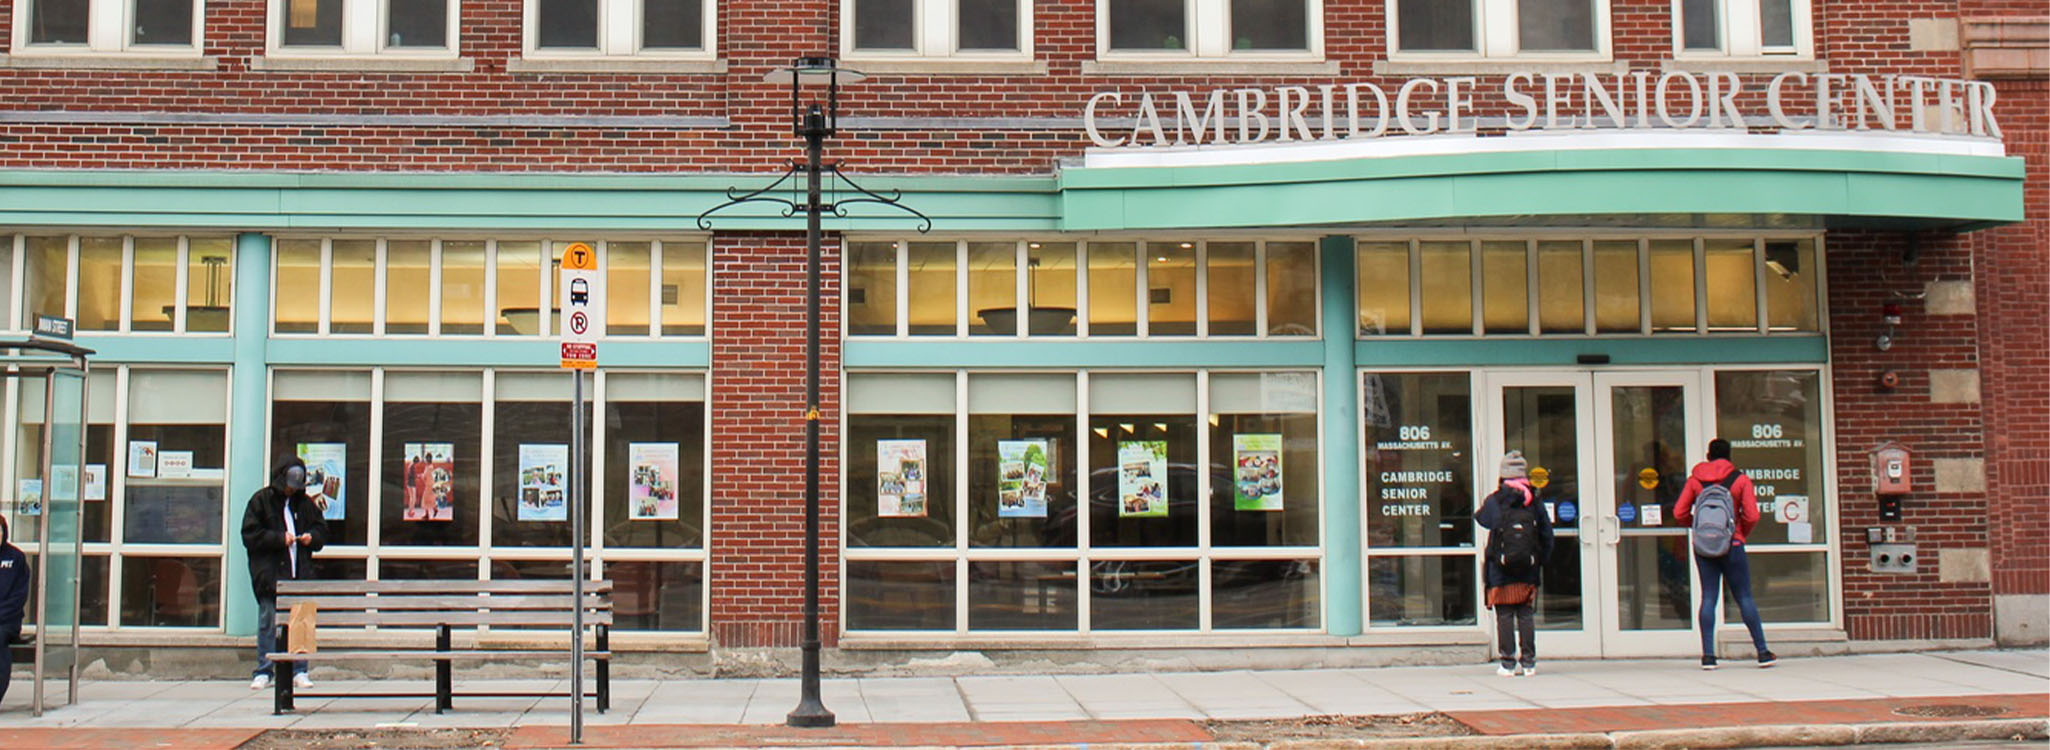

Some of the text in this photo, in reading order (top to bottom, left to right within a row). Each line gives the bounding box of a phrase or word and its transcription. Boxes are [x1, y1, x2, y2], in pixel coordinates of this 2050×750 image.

[1084, 71, 2003, 148] CAMBRIDGE SENIOR CENTER
[574, 251, 585, 264] T
[1400, 426, 1430, 440] 806
[1752, 424, 1782, 438] 806
[1381, 471, 1453, 482] CAMBRIDGE
[1740, 469, 1800, 480] MBRIDGE
[1382, 487, 1427, 499] SENIOR
[1754, 485, 1775, 496] IOR
[1382, 504, 1431, 516] CENTER
